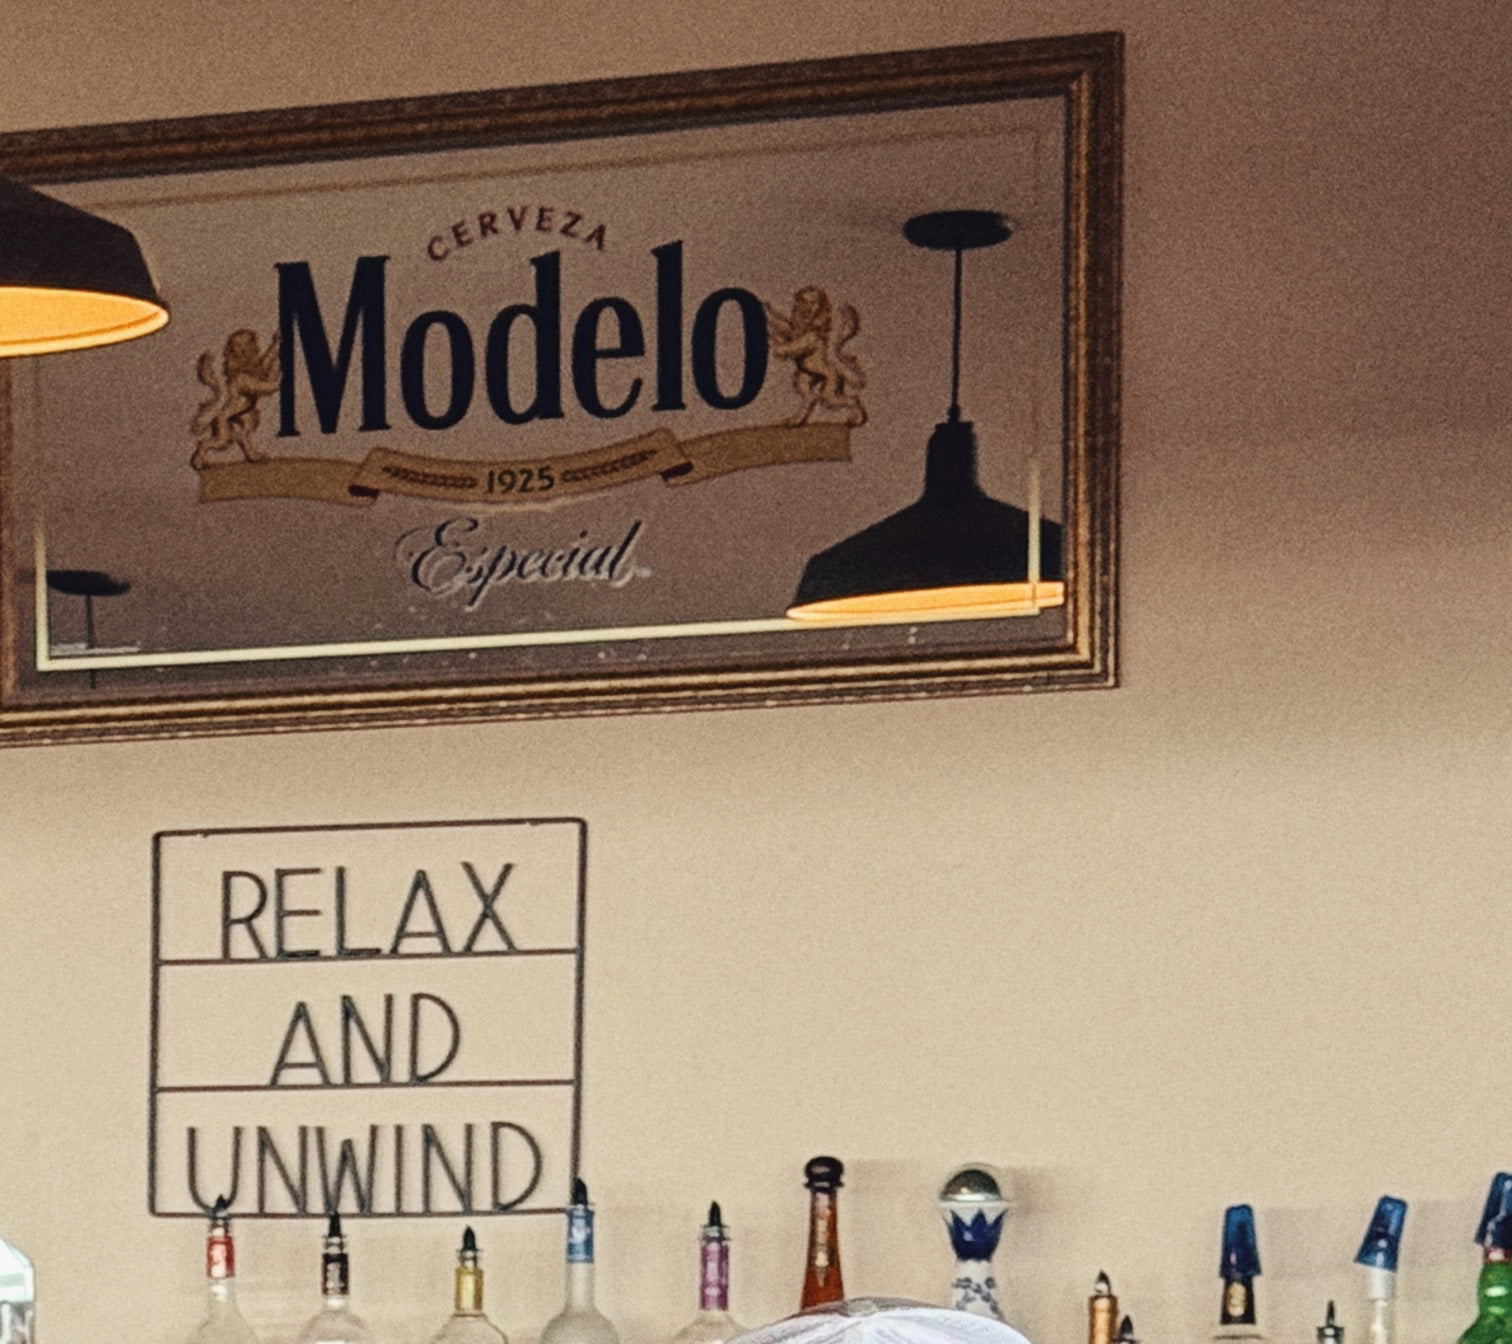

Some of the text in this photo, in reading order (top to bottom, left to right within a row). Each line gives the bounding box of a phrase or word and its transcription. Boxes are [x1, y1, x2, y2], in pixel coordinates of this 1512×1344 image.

[427, 205, 607, 262] CERVEZA
[274, 240, 770, 438] Modelo
[488, 466, 556, 495] 1925
[396, 517, 644, 610] Especial
[222, 861, 517, 960] RELAX
[269, 991, 461, 1086] AND
[187, 1121, 543, 1215] UNWIND
